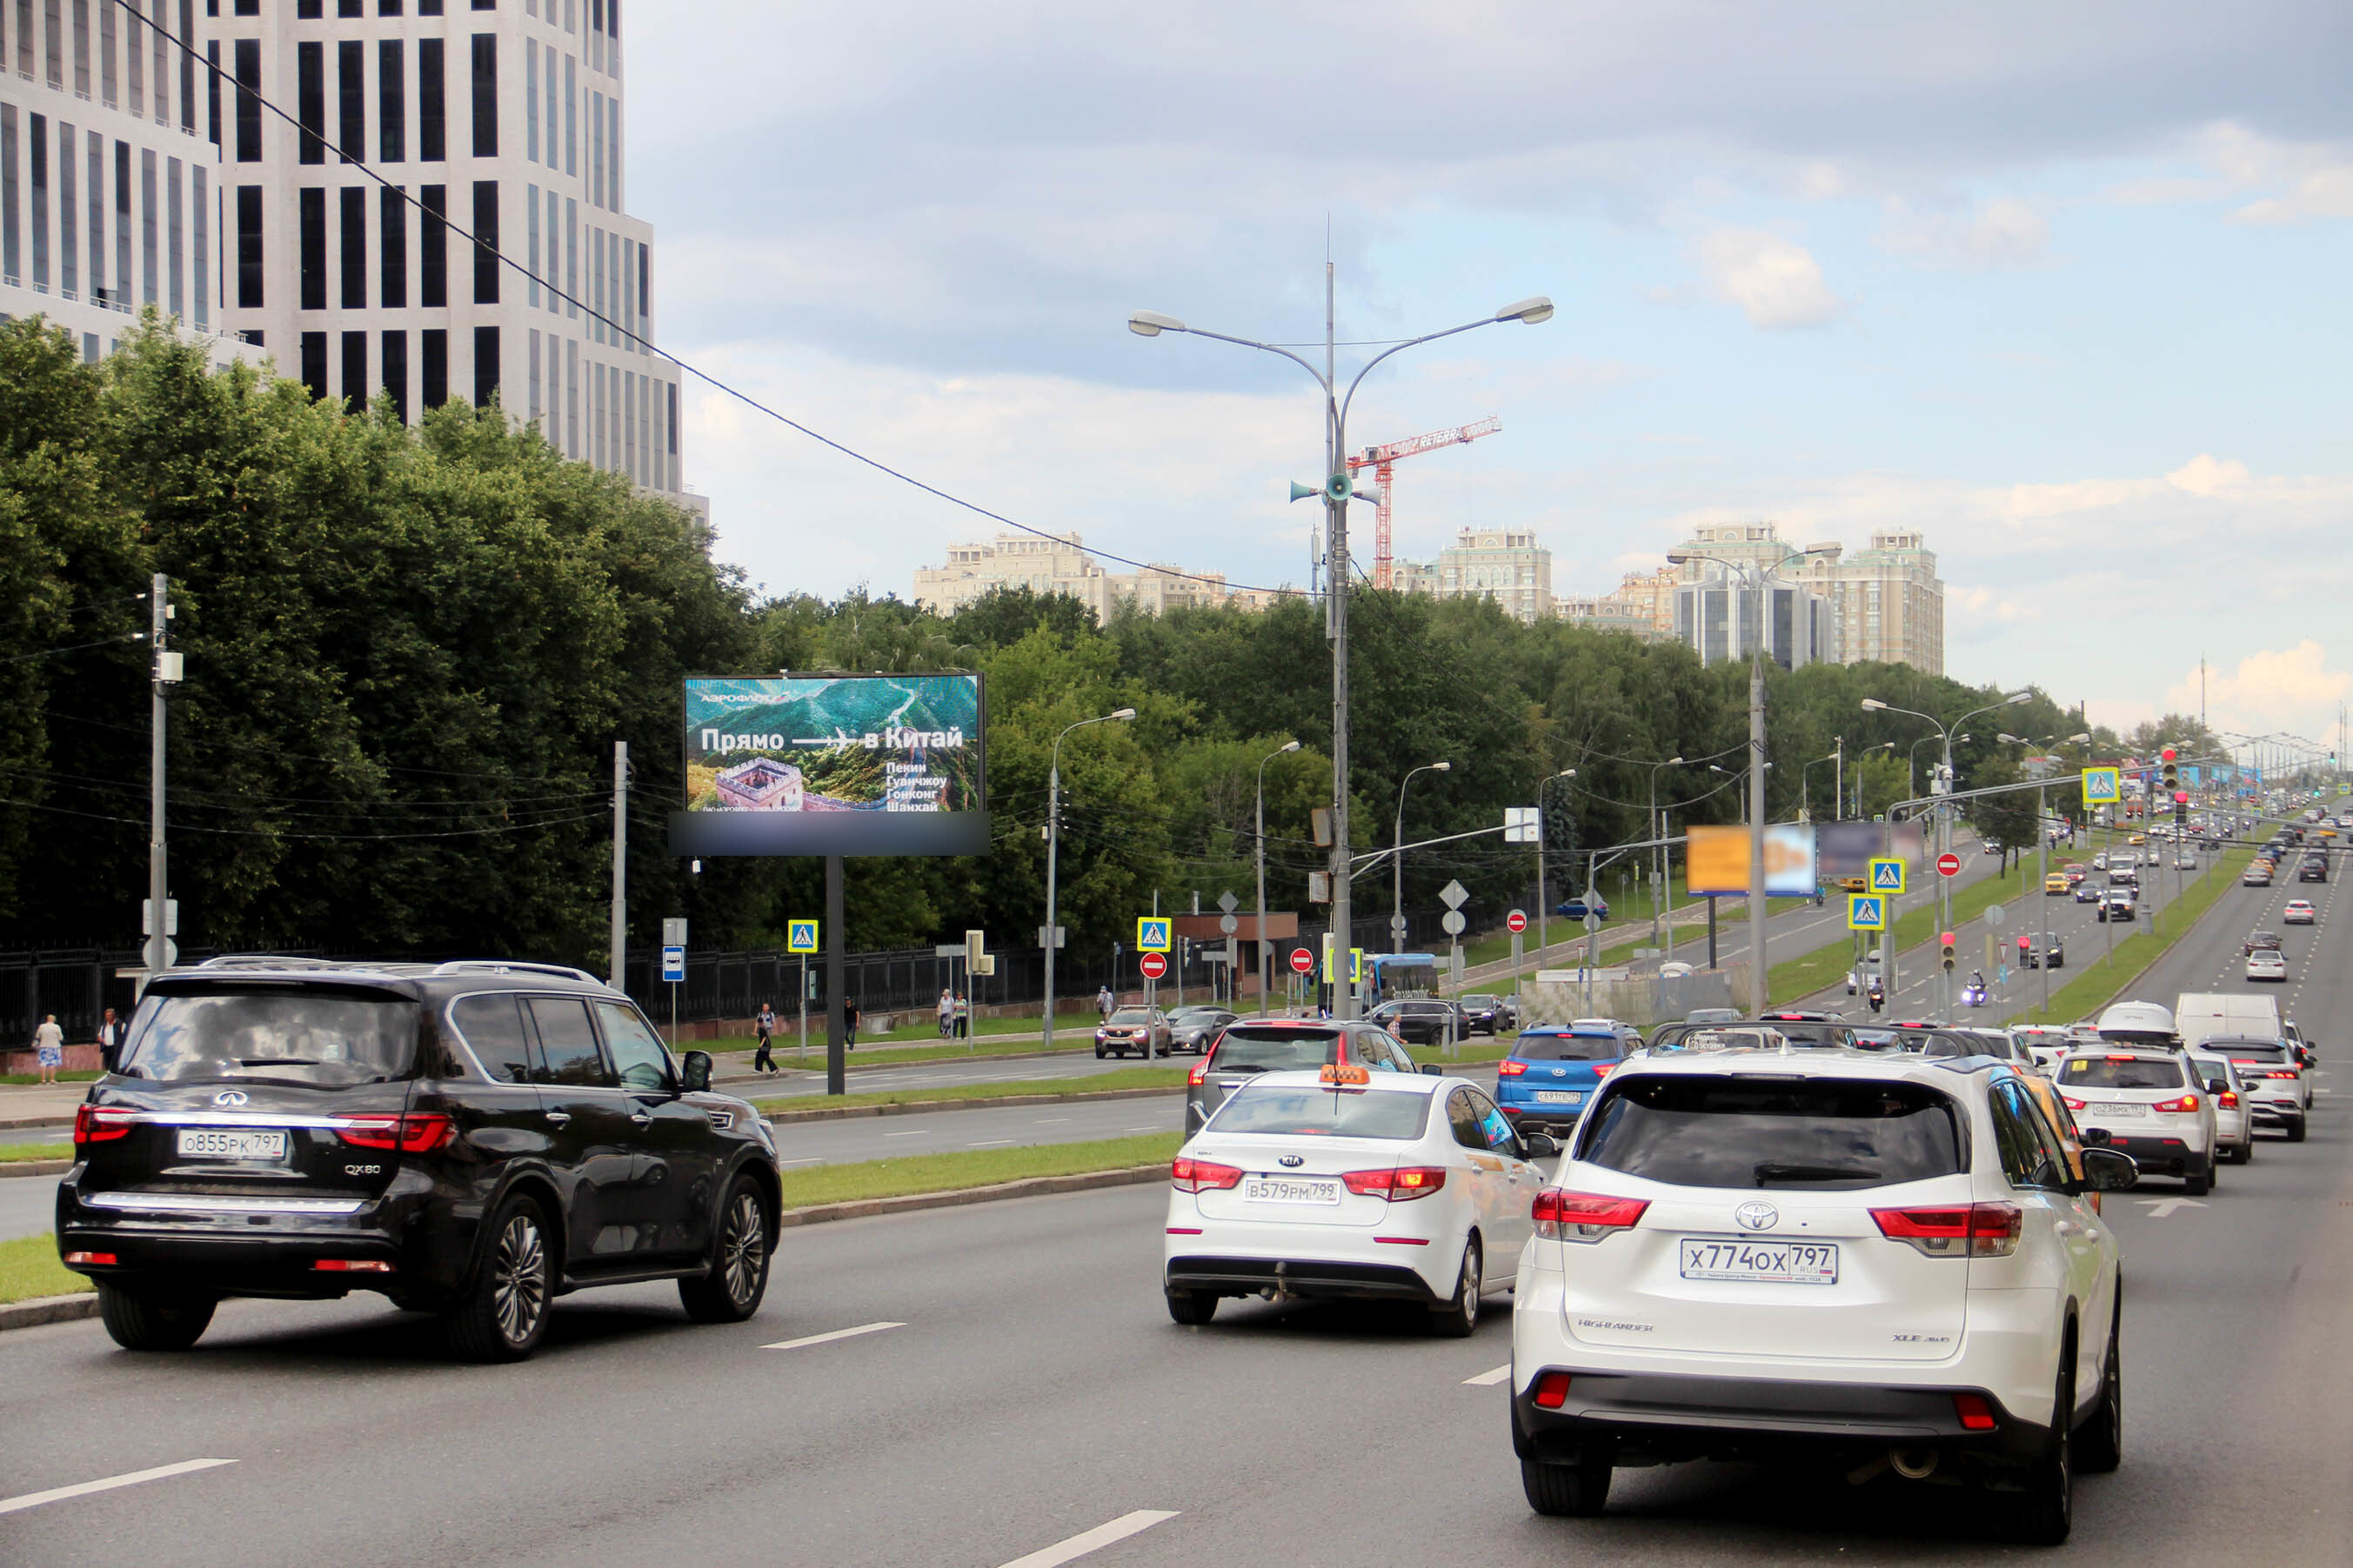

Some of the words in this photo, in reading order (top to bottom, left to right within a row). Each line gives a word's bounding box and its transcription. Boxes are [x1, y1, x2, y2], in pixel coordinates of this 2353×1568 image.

[702, 728, 785, 756] Прямо
[865, 732, 879, 749] в
[886, 725, 963, 748] Китай
[886, 762, 927, 773] Пекин
[886, 775, 947, 788] Гуанчжоу
[886, 788, 939, 799] Гонконг
[886, 801, 939, 812] Шанхай
[254, 1134, 279, 1150] 797
[1280, 1155, 1302, 1166] KIA
[344, 1164, 381, 1176] QX80
[1312, 1183, 1334, 1197] 799
[1792, 1246, 1830, 1266] 797
[1800, 1265, 1819, 1274] RUS
[1578, 1318, 1654, 1332] HIGHLANDER
